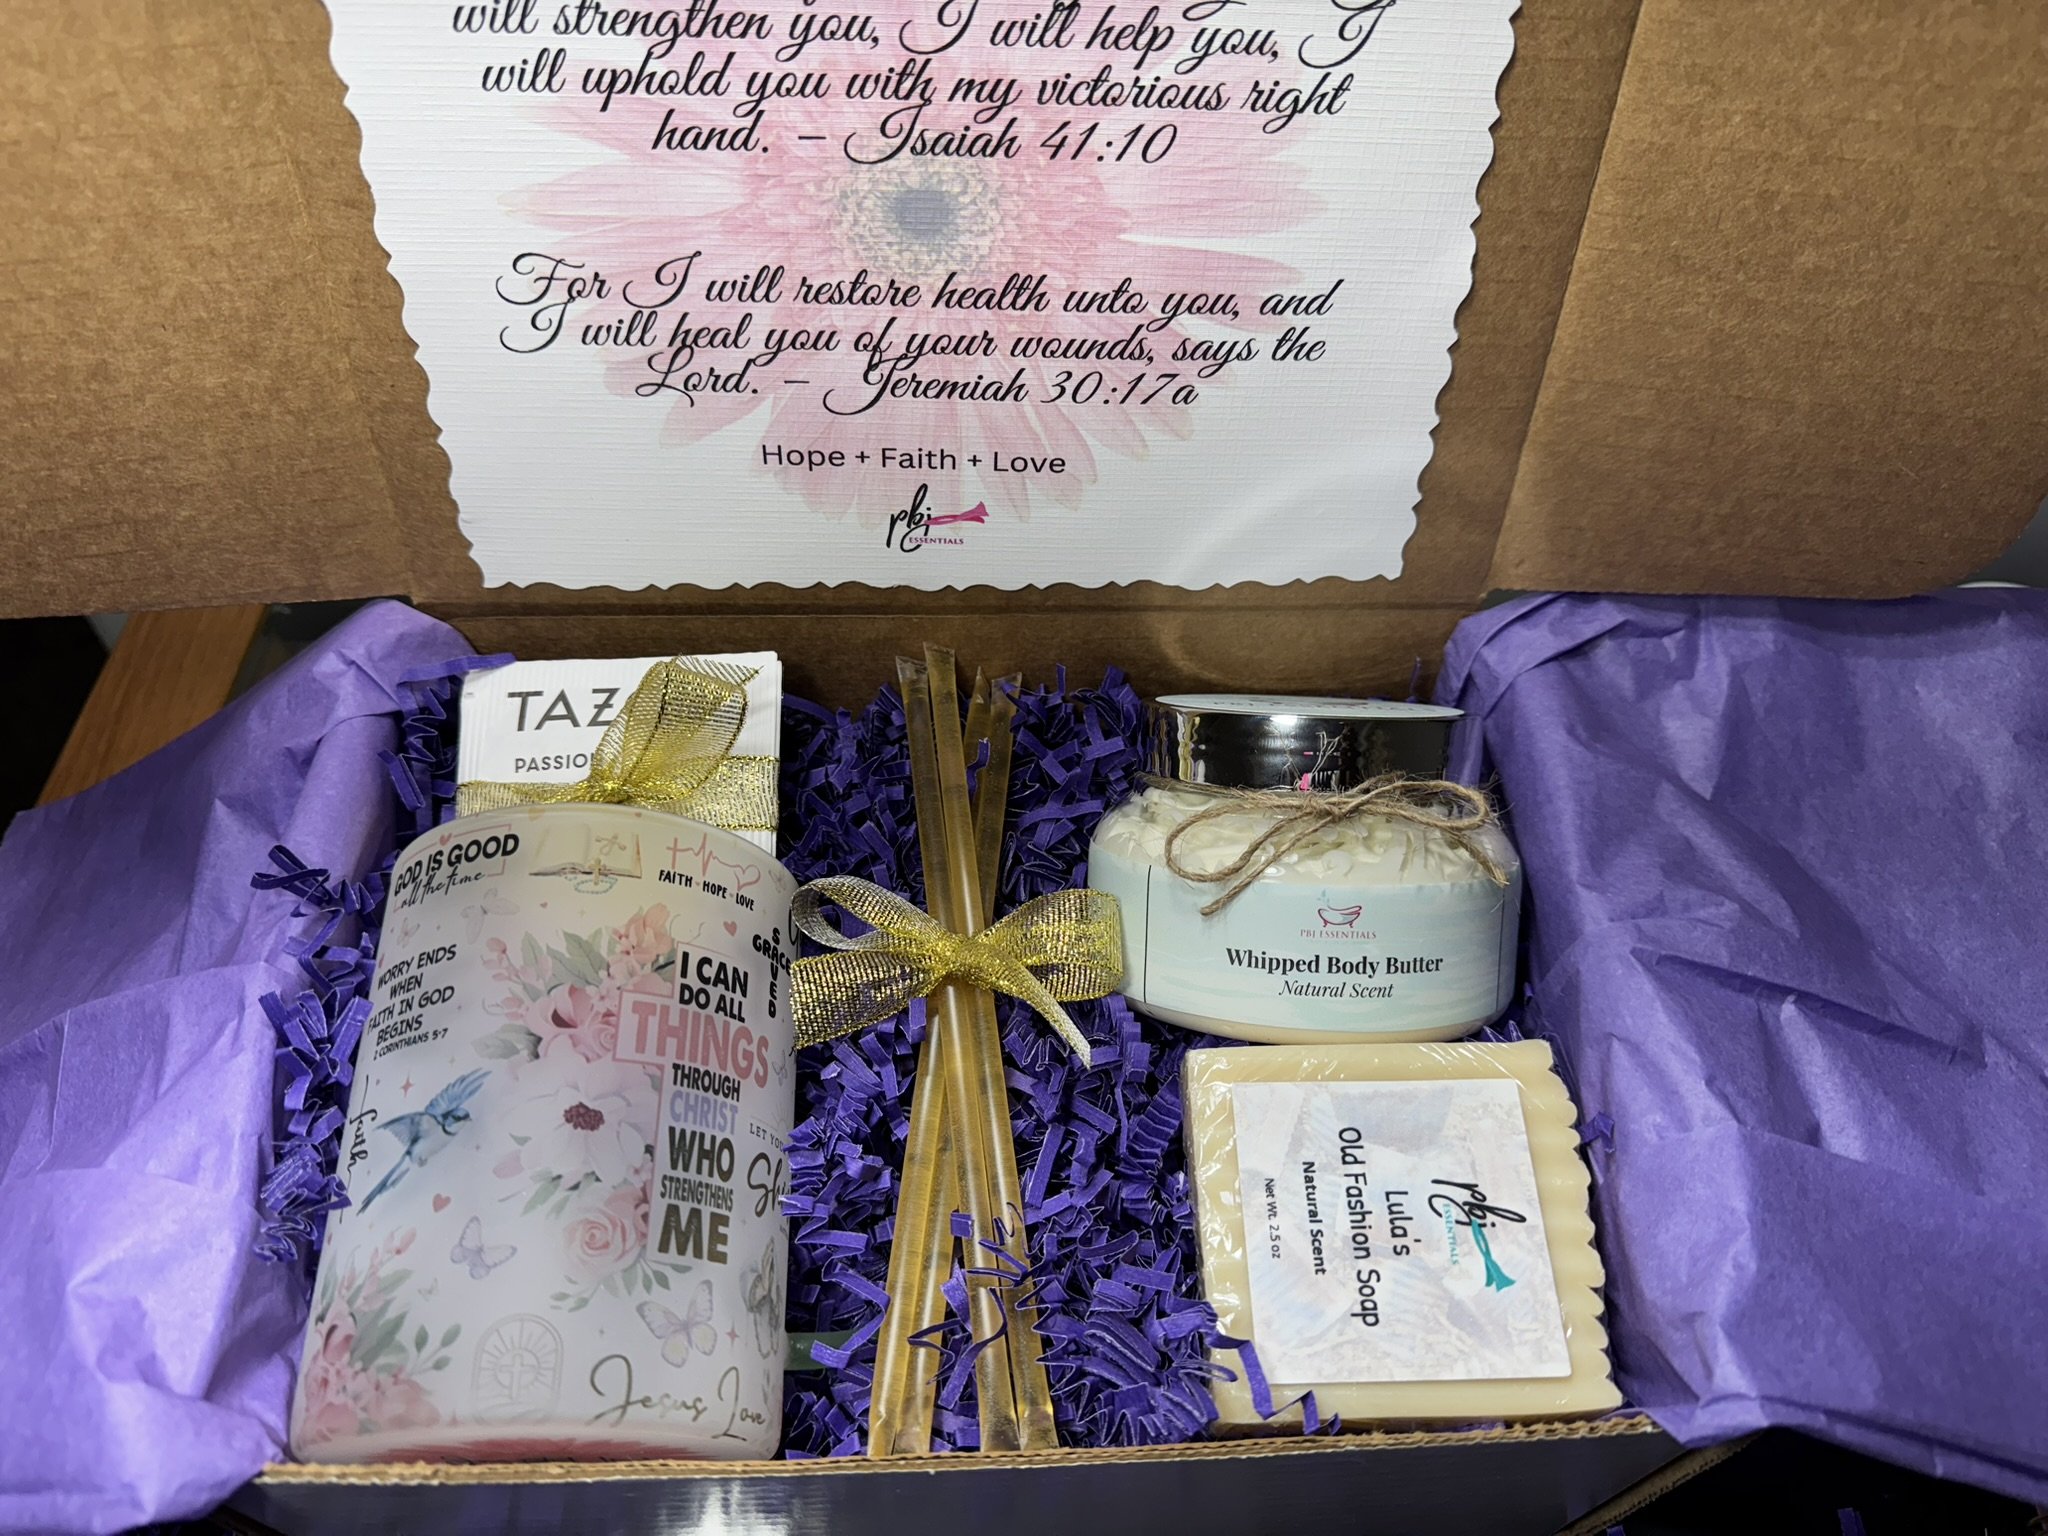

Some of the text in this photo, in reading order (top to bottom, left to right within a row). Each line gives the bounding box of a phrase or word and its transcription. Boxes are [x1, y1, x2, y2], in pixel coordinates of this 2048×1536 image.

[452, 0, 1396, 75] will strengthen you, I will help you, I
[482, 47, 1356, 134] will uphold you with my victorious right
[651, 108, 769, 153] hand.
[844, 101, 1022, 164] Isaiah
[1040, 121, 1178, 164] 41:10
[495, 250, 1345, 333] For I will restore health unto you, and
[499, 296, 1327, 378] I will heal you of your wounds, says the
[635, 345, 759, 408] Lord.
[823, 353, 1029, 415] Jeremiah
[1040, 370, 1199, 406] 30:17a
[762, 444, 846, 472] Hope
[881, 447, 957, 471] Faith
[993, 450, 1067, 474] Love
[908, 536, 964, 545] ESSENTIALS
[507, 687, 621, 732] TAZ
[515, 752, 595, 773] PASSIO
[394, 833, 520, 897] GOD IS GOOD
[400, 879, 422, 909] all
[443, 865, 486, 896] time
[658, 869, 755, 912] FAITH HOPE LOVE
[1300, 929, 1377, 940] PBJ ESSENTIALS
[377, 943, 457, 991] WORRY ENDS
[389, 972, 424, 1001] WHEN
[680, 951, 748, 999] I CAN
[1225, 946, 1444, 979] Whipped Body Butter
[367, 985, 455, 1036] FAITH IN GOD
[679, 983, 746, 1024] DO ALL
[1278, 979, 1393, 999] Natural Scent
[376, 1013, 424, 1047] BEGINS
[378, 1031, 429, 1058] CORINTHIANS
[631, 1000, 769, 1089] THINGS
[672, 1063, 741, 1103] THROUGH
[669, 1089, 739, 1136] CHRIST
[749, 1122, 768, 1141] LET
[668, 1125, 736, 1183] WHO
[660, 1174, 734, 1214] STRENGTHENS
[657, 1203, 731, 1266] ME
[1264, 1177, 1281, 1260] Net Wt. 2.5 oz
[1302, 1161, 1327, 1276] Natural Scent
[1338, 1127, 1381, 1328] Old Fashion Soap
[1384, 1189, 1422, 1257] Lula's
[1443, 1203, 1459, 1265] ESSENTIALS
[585, 1353, 708, 1428] Jesus
